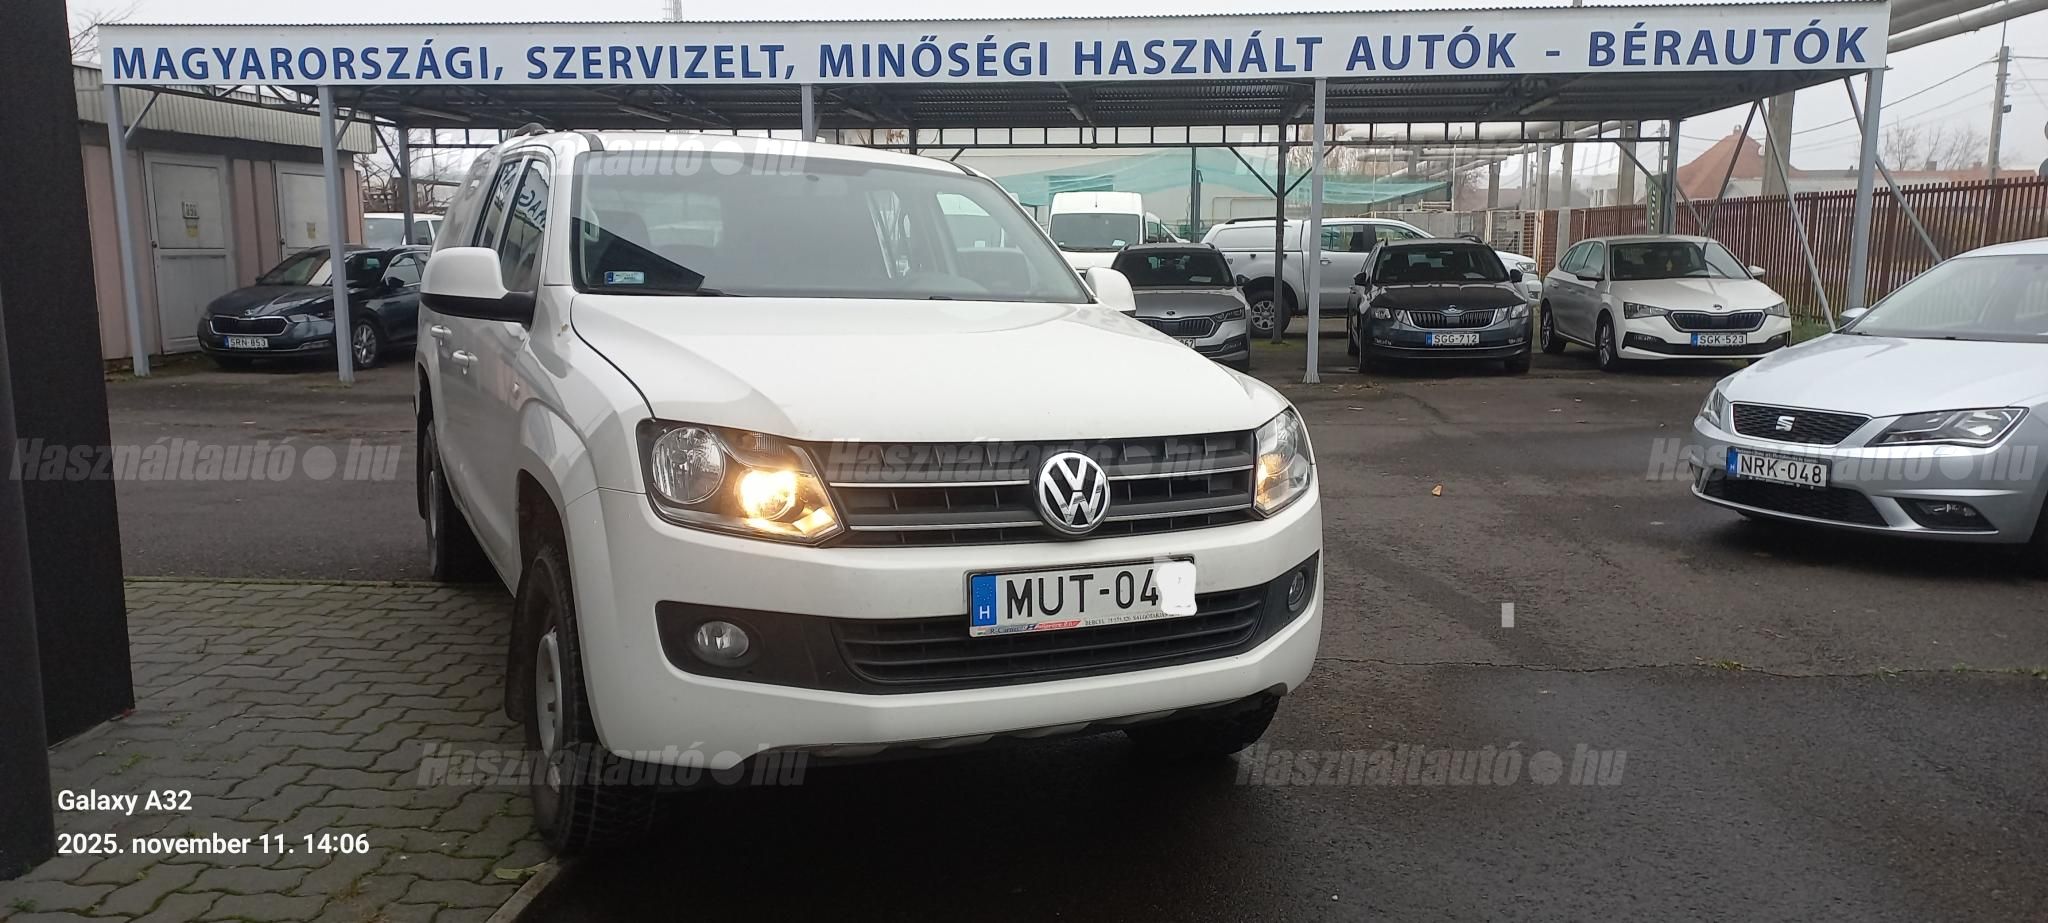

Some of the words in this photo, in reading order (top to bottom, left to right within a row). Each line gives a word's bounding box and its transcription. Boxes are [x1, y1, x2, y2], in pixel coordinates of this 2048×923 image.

[112, 38, 503, 81] MAGYARORSZÁGI,
[526, 44, 796, 81] SZERVIZELT,
[819, 35, 1048, 78] MINŐSÉGI
[1074, 31, 1323, 76] HASZNÁLT
[1347, 25, 1517, 71] AUTÓK
[1588, 19, 1869, 67] BÉRAUTÓK
[1433, 334, 1478, 344] SGG-712
[1699, 335, 1745, 344] SGK-523
[1740, 454, 1822, 484] NRK-048
[979, 605, 990, 620] H
[1006, 569, 1160, 620] MUT-04
